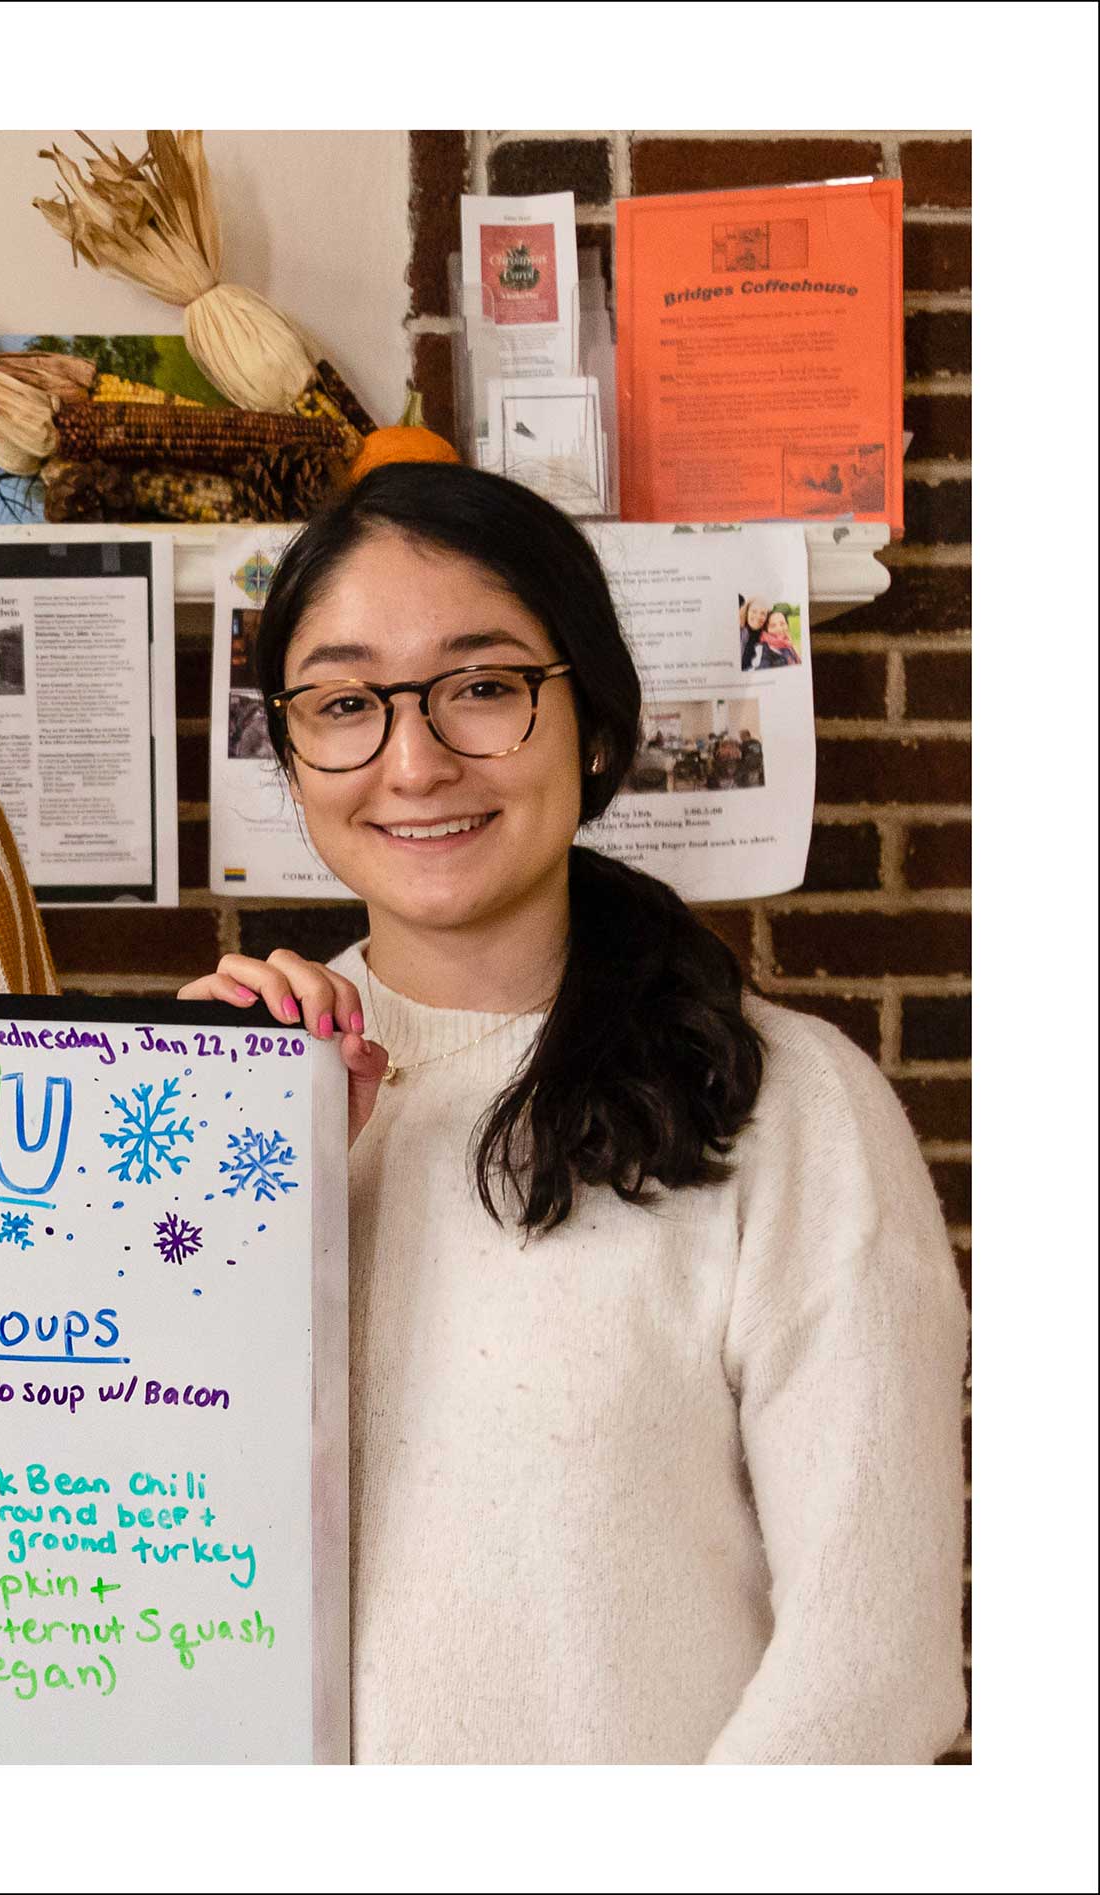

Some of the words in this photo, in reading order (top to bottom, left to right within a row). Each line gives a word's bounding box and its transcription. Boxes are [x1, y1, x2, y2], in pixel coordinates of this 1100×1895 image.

[663, 285, 734, 308] Bridges
[741, 279, 858, 297] Coffeehouse
[140, 1025, 188, 1055] Jan
[192, 1033, 240, 1063] 22,
[245, 1033, 306, 1058] 2020
[21, 1382, 86, 1414] soup
[98, 1374, 139, 1404] w/
[144, 1379, 231, 1411] Bacon
[25, 1463, 112, 1497] Bean
[7, 1527, 118, 1565] ground
[130, 1535, 258, 1590] turkey
[89, 1576, 123, 1605] +
[135, 1606, 276, 1671] Squash
